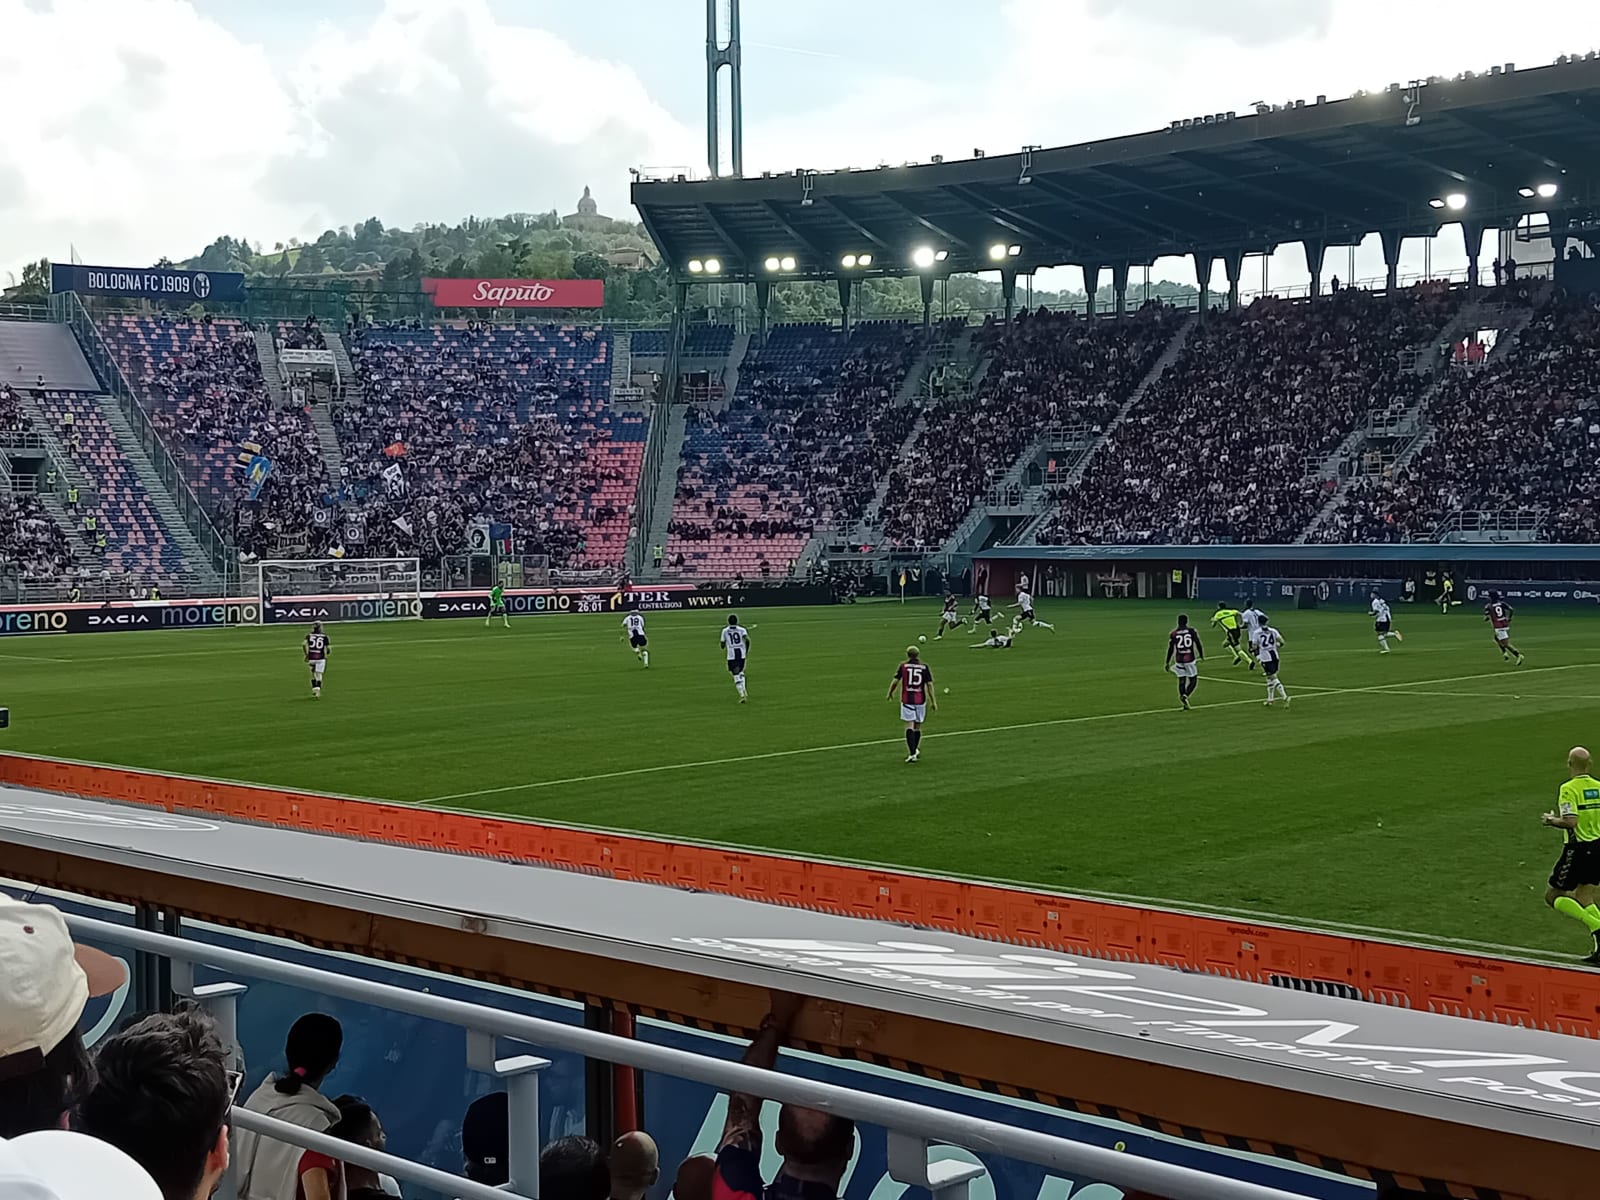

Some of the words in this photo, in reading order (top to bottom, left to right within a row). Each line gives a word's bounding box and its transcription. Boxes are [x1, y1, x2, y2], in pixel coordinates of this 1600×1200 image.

[88, 272, 141, 290] BOLOGNA
[144, 274, 158, 291] FC
[161, 275, 190, 293] 1909
[472, 281, 555, 306] Saputo
[161, 604, 257, 624] moreno
[275, 608, 329, 618] DACIA
[340, 599, 423, 618] moreno
[438, 603, 487, 611] DACIA
[578, 602, 602, 613] 26:01
[1495, 606, 1503, 617] 9
[0, 612, 68, 631] reno
[88, 614, 149, 625] DACIA
[630, 617, 640, 627] 18
[308, 635, 324, 650] 56
[728, 632, 741, 645] 19
[1175, 633, 1193, 648] 26
[1260, 634, 1275, 648] 24
[907, 668, 923, 686] 15
[1013, 1001, 1134, 1020] per
